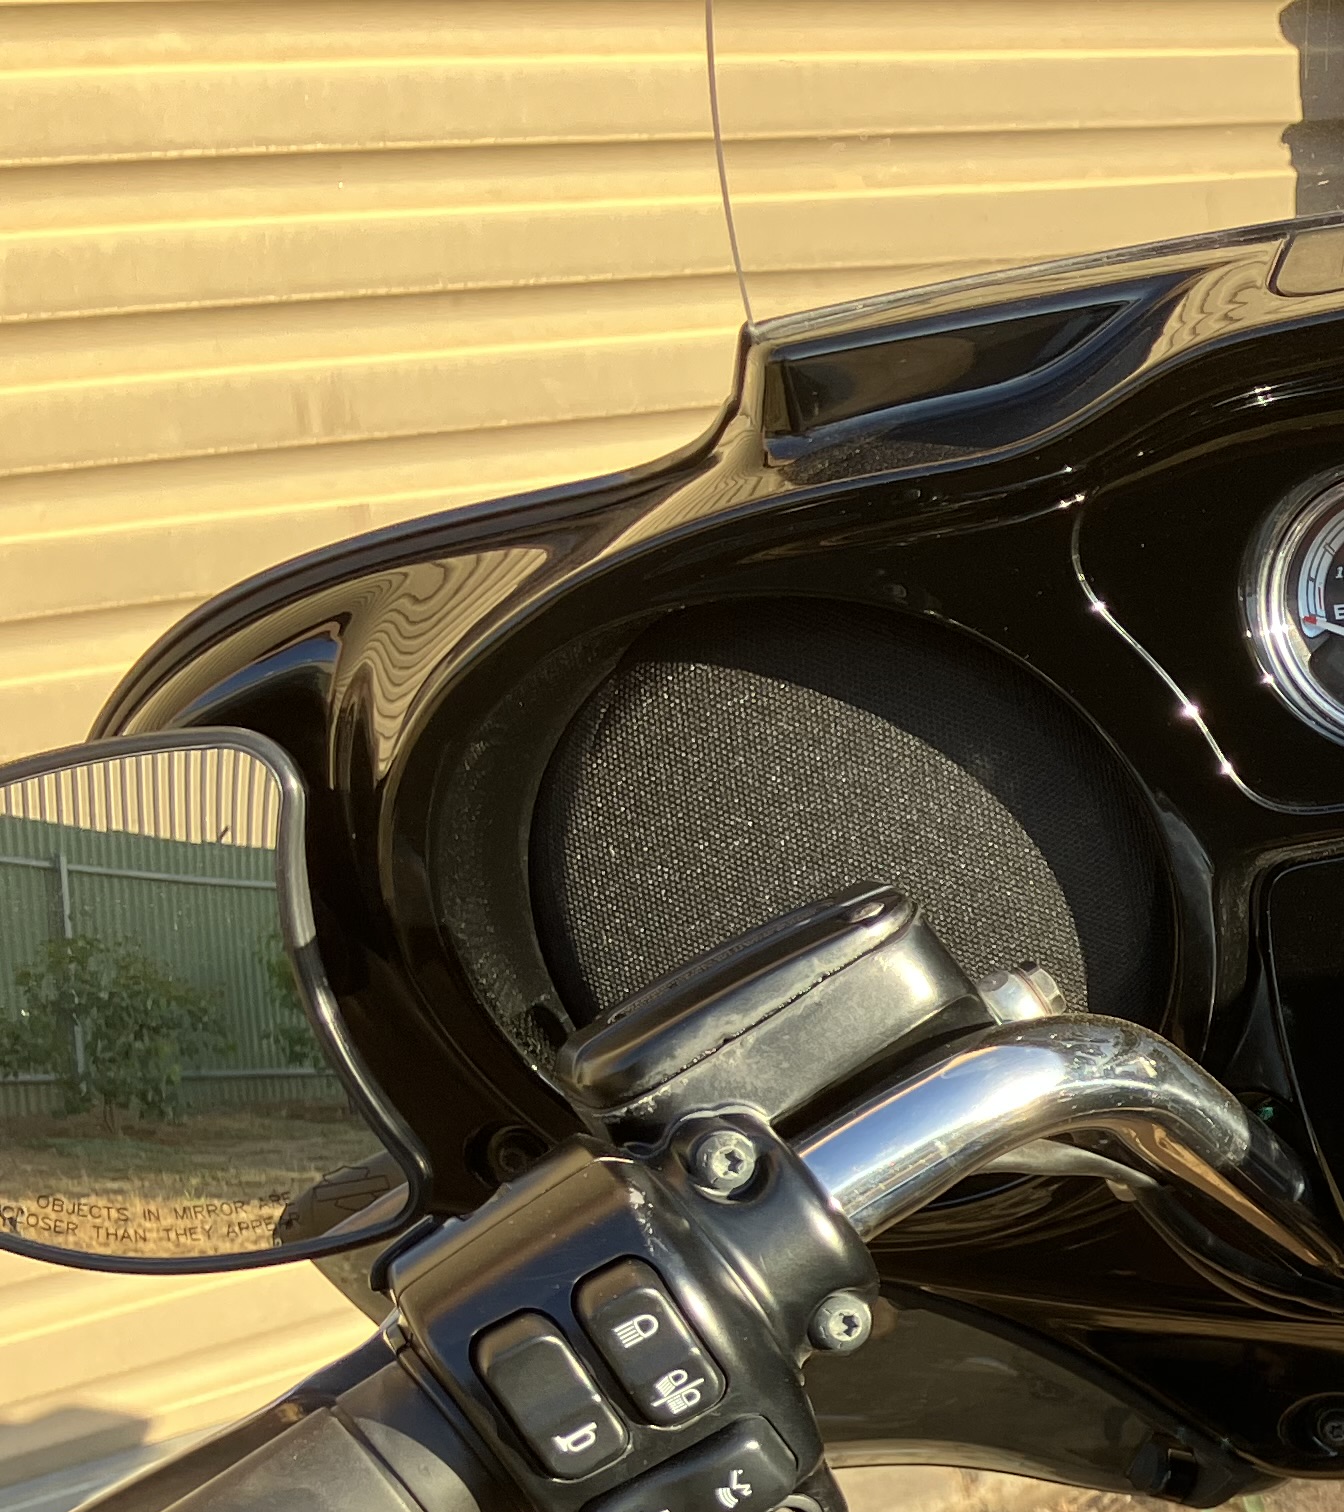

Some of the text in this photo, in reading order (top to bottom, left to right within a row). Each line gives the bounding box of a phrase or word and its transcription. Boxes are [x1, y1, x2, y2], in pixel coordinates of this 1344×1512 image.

[36, 1194, 130, 1222] OBJECTS
[142, 1207, 161, 1222] IN
[173, 1200, 248, 1220] MIRROR
[92, 1225, 147, 1242] THAN
[162, 1224, 213, 1243] THEY
